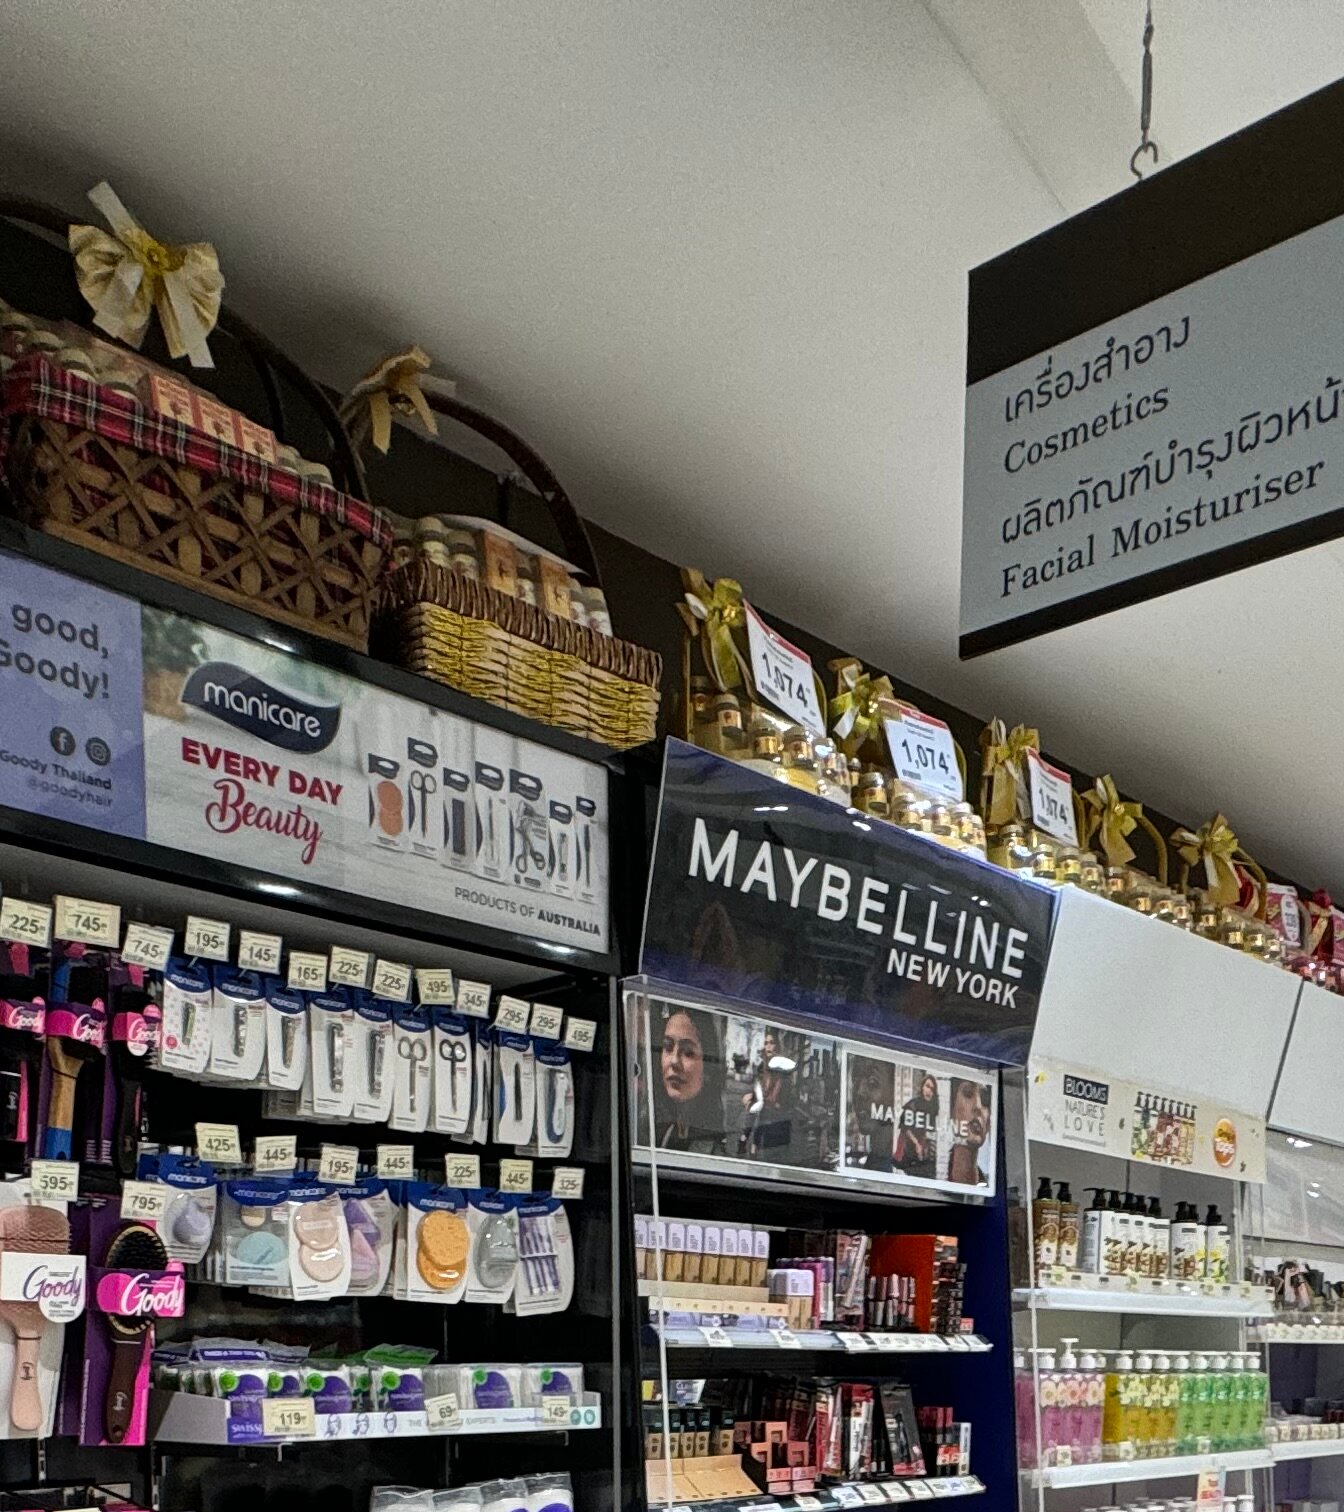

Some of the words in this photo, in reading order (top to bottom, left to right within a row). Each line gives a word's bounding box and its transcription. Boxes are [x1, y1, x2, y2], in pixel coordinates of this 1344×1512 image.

[1004, 387, 1170, 474] Cosmetics
[1000, 535, 1095, 598] Facial
[1111, 459, 1326, 559] Moisturiser
[12, 596, 110, 661] good,
[203, 680, 321, 739] manicare
[0, 749, 47, 774] Goody
[51, 759, 113, 791] Thailand
[181, 737, 278, 786] EVERY
[288, 772, 343, 805] DAY
[205, 779, 324, 864] Beauty
[455, 886, 516, 918] PRODUCTS
[519, 903, 535, 919] OF
[538, 907, 601, 936] AUSTRALIA
[688, 816, 1030, 979] MAYBELLINE
[886, 948, 951, 989] NEW
[955, 967, 1020, 1009] YORK
[870, 1101, 969, 1137] MAYBELLINE
[23, 1264, 81, 1302] Goody
[121, 1273, 184, 1317] Goody
